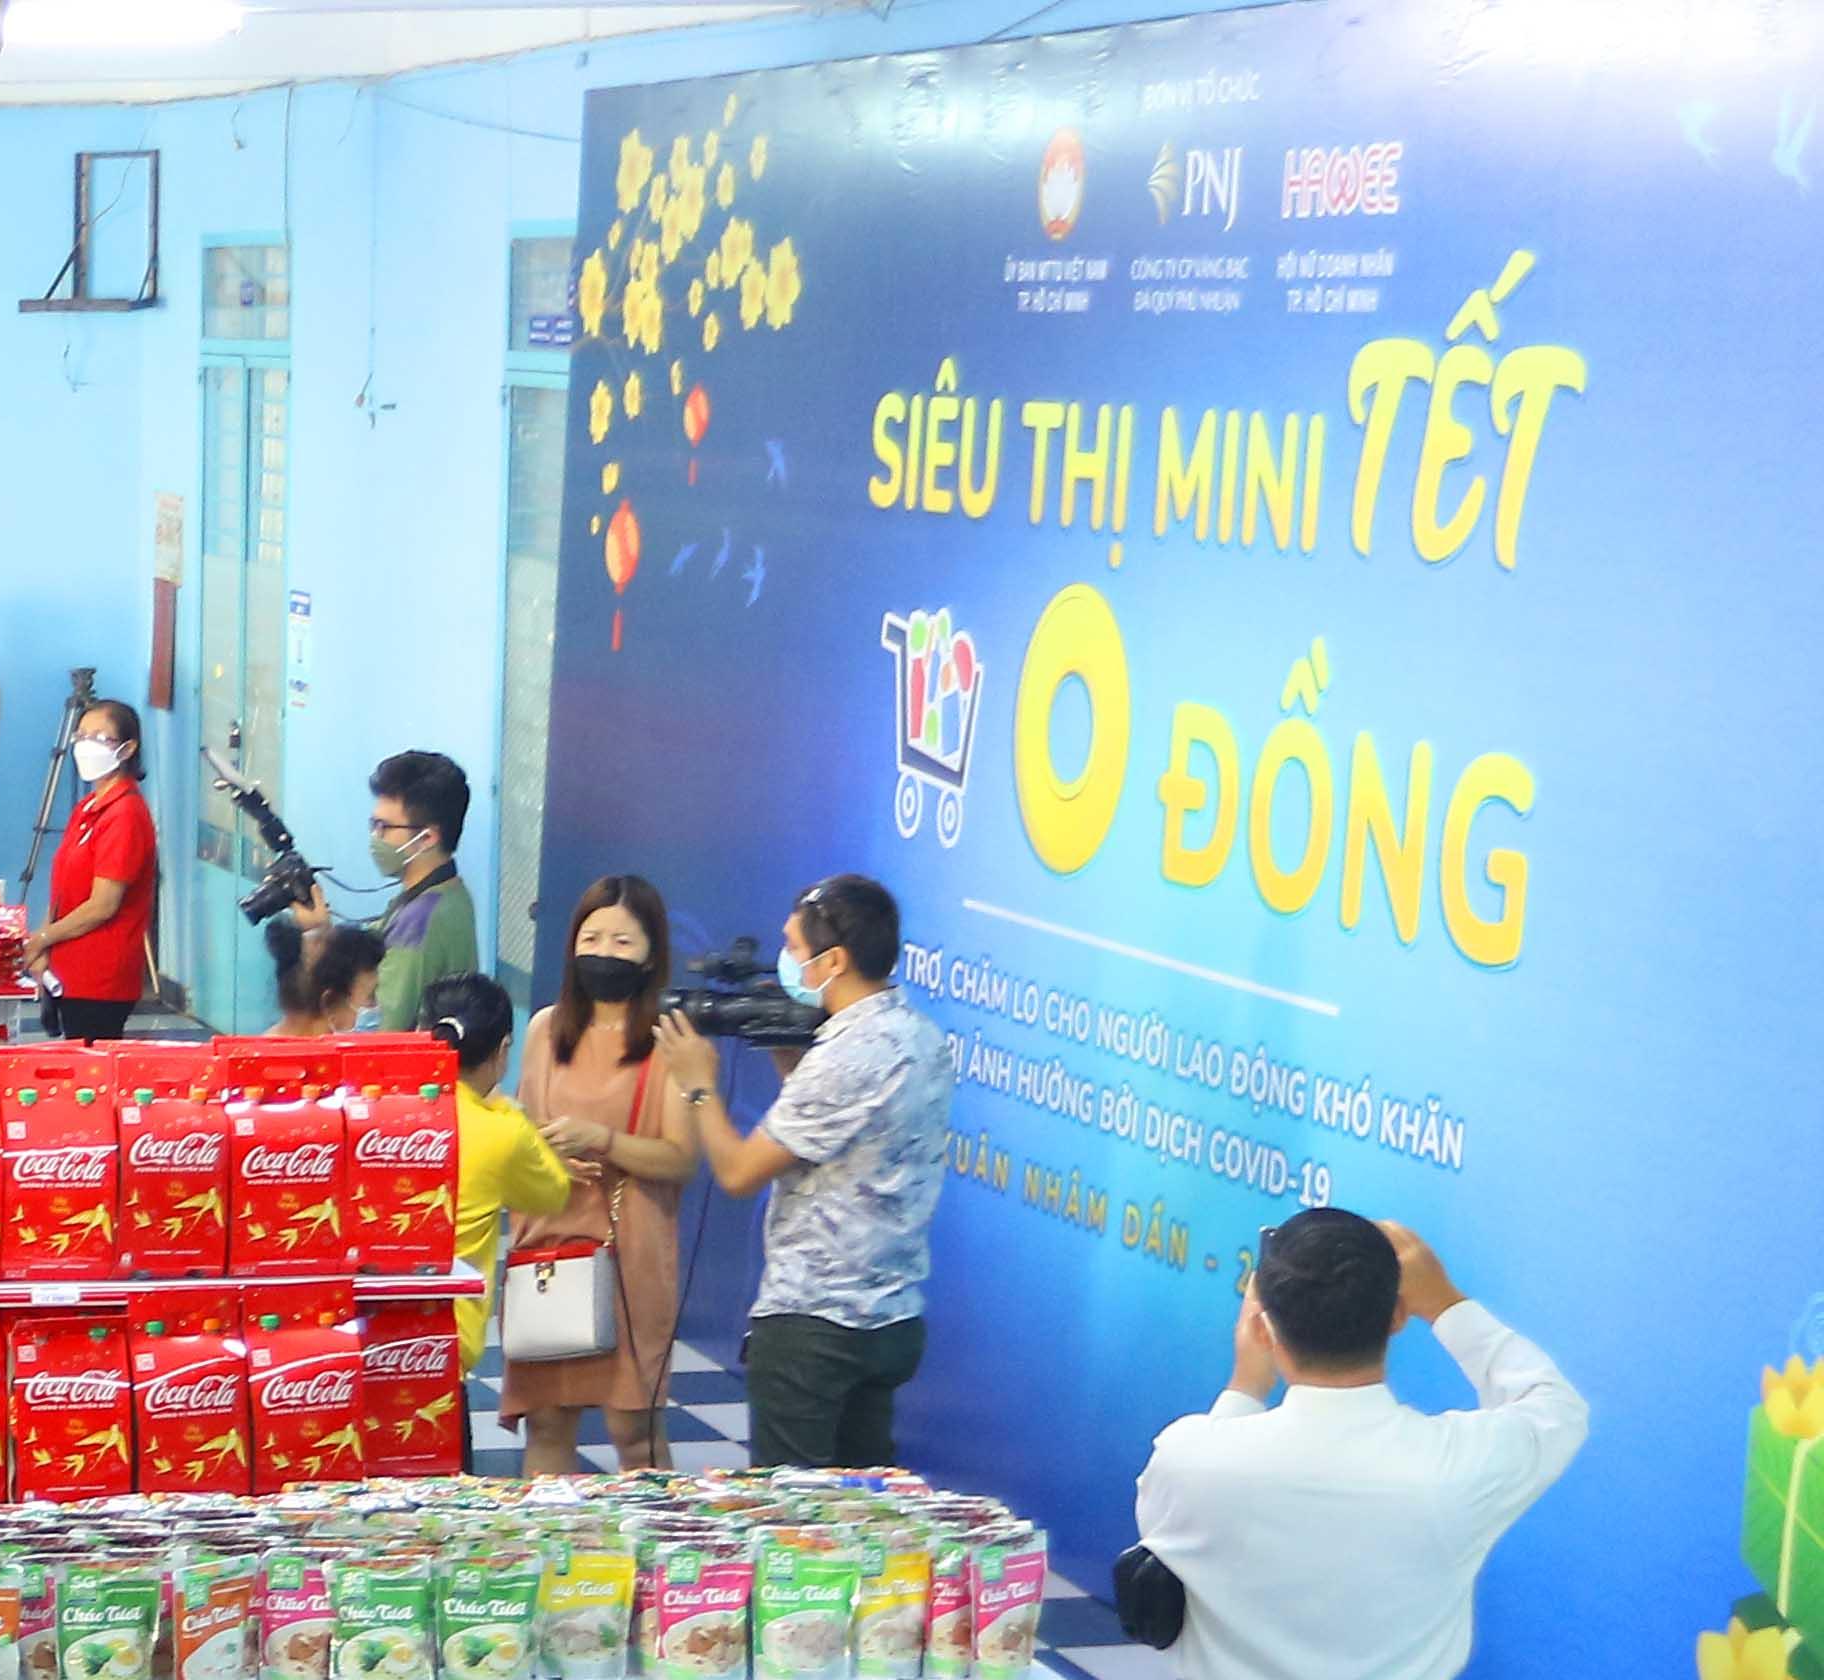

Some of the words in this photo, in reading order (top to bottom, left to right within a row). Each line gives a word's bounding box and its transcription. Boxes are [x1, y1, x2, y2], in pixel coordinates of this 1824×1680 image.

[1181, 146, 1244, 231] PNJ
[868, 356, 1002, 519] SIÊU
[1022, 401, 1132, 571] THỊ
[1153, 406, 1326, 556] MINI
[1347, 249, 1587, 572] TẾT
[1157, 636, 1536, 968] ĐỒNG
[949, 958, 1008, 1014] CHĂM
[1012, 980, 1038, 1027] LO
[1044, 989, 1092, 1044] CHO
[1096, 1006, 1169, 1068] NGƯỜI
[1175, 1033, 1223, 1089] LAO
[1228, 1046, 1305, 1116] ĐỘNG
[1314, 1069, 1373, 1139] KHÓ
[1379, 1097, 1464, 1170] KHĂN
[129, 1130, 227, 1168] Coca-Cola
[355, 1126, 453, 1164] Coca-Cola
[968, 1031, 1011, 1093] ẢNH
[1015, 1056, 1093, 1133] HƯỞNG
[1099, 1084, 1140, 1141] BỞI
[1145, 1105, 1202, 1167] DỊCH
[1209, 1131, 1332, 1209] COVID-19
[242, 1141, 340, 1181] Coca-Cola
[1024, 1162, 1108, 1237] NHÂM
[260, 1369, 357, 1408] Coca-Cola
